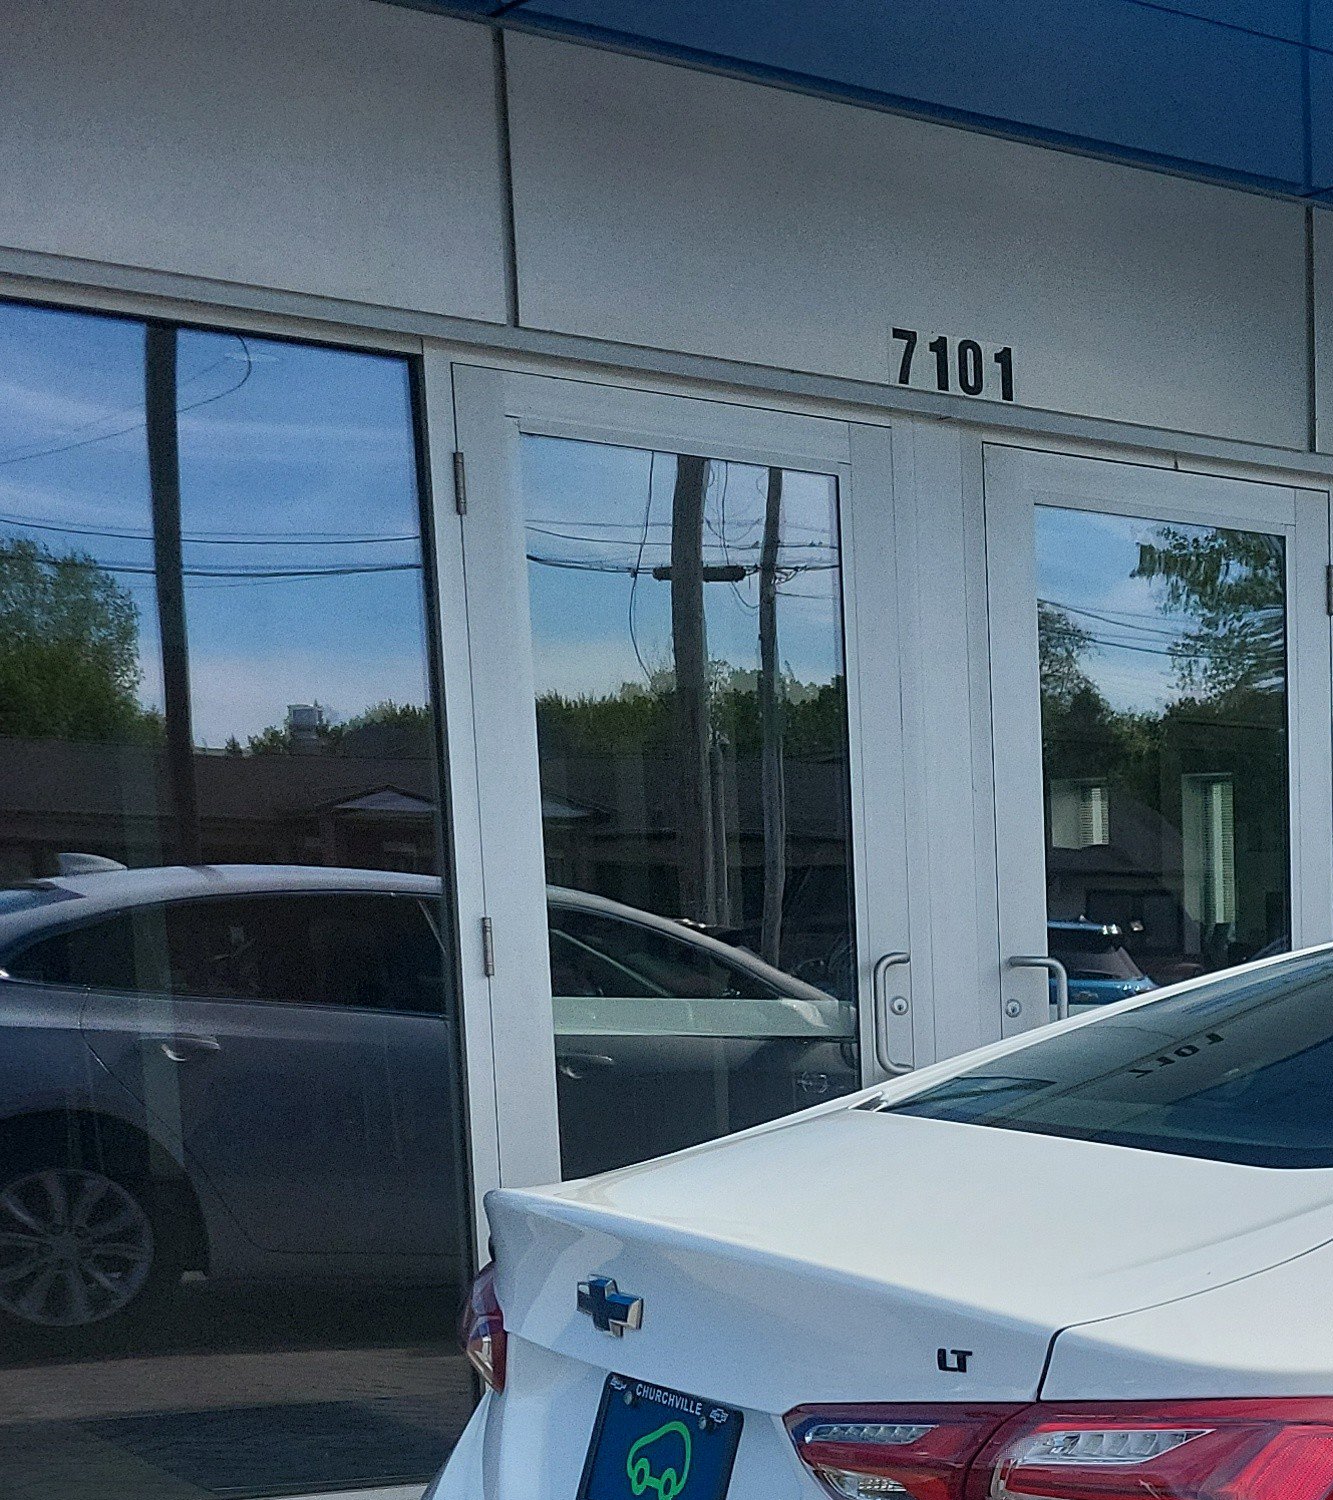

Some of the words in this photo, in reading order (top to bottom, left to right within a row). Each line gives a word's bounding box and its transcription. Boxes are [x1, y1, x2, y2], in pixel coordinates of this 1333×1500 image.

[892, 327, 1014, 401] 7101
[937, 1348, 973, 1373] LT
[635, 1383, 703, 1416] CHURCHVILLE
